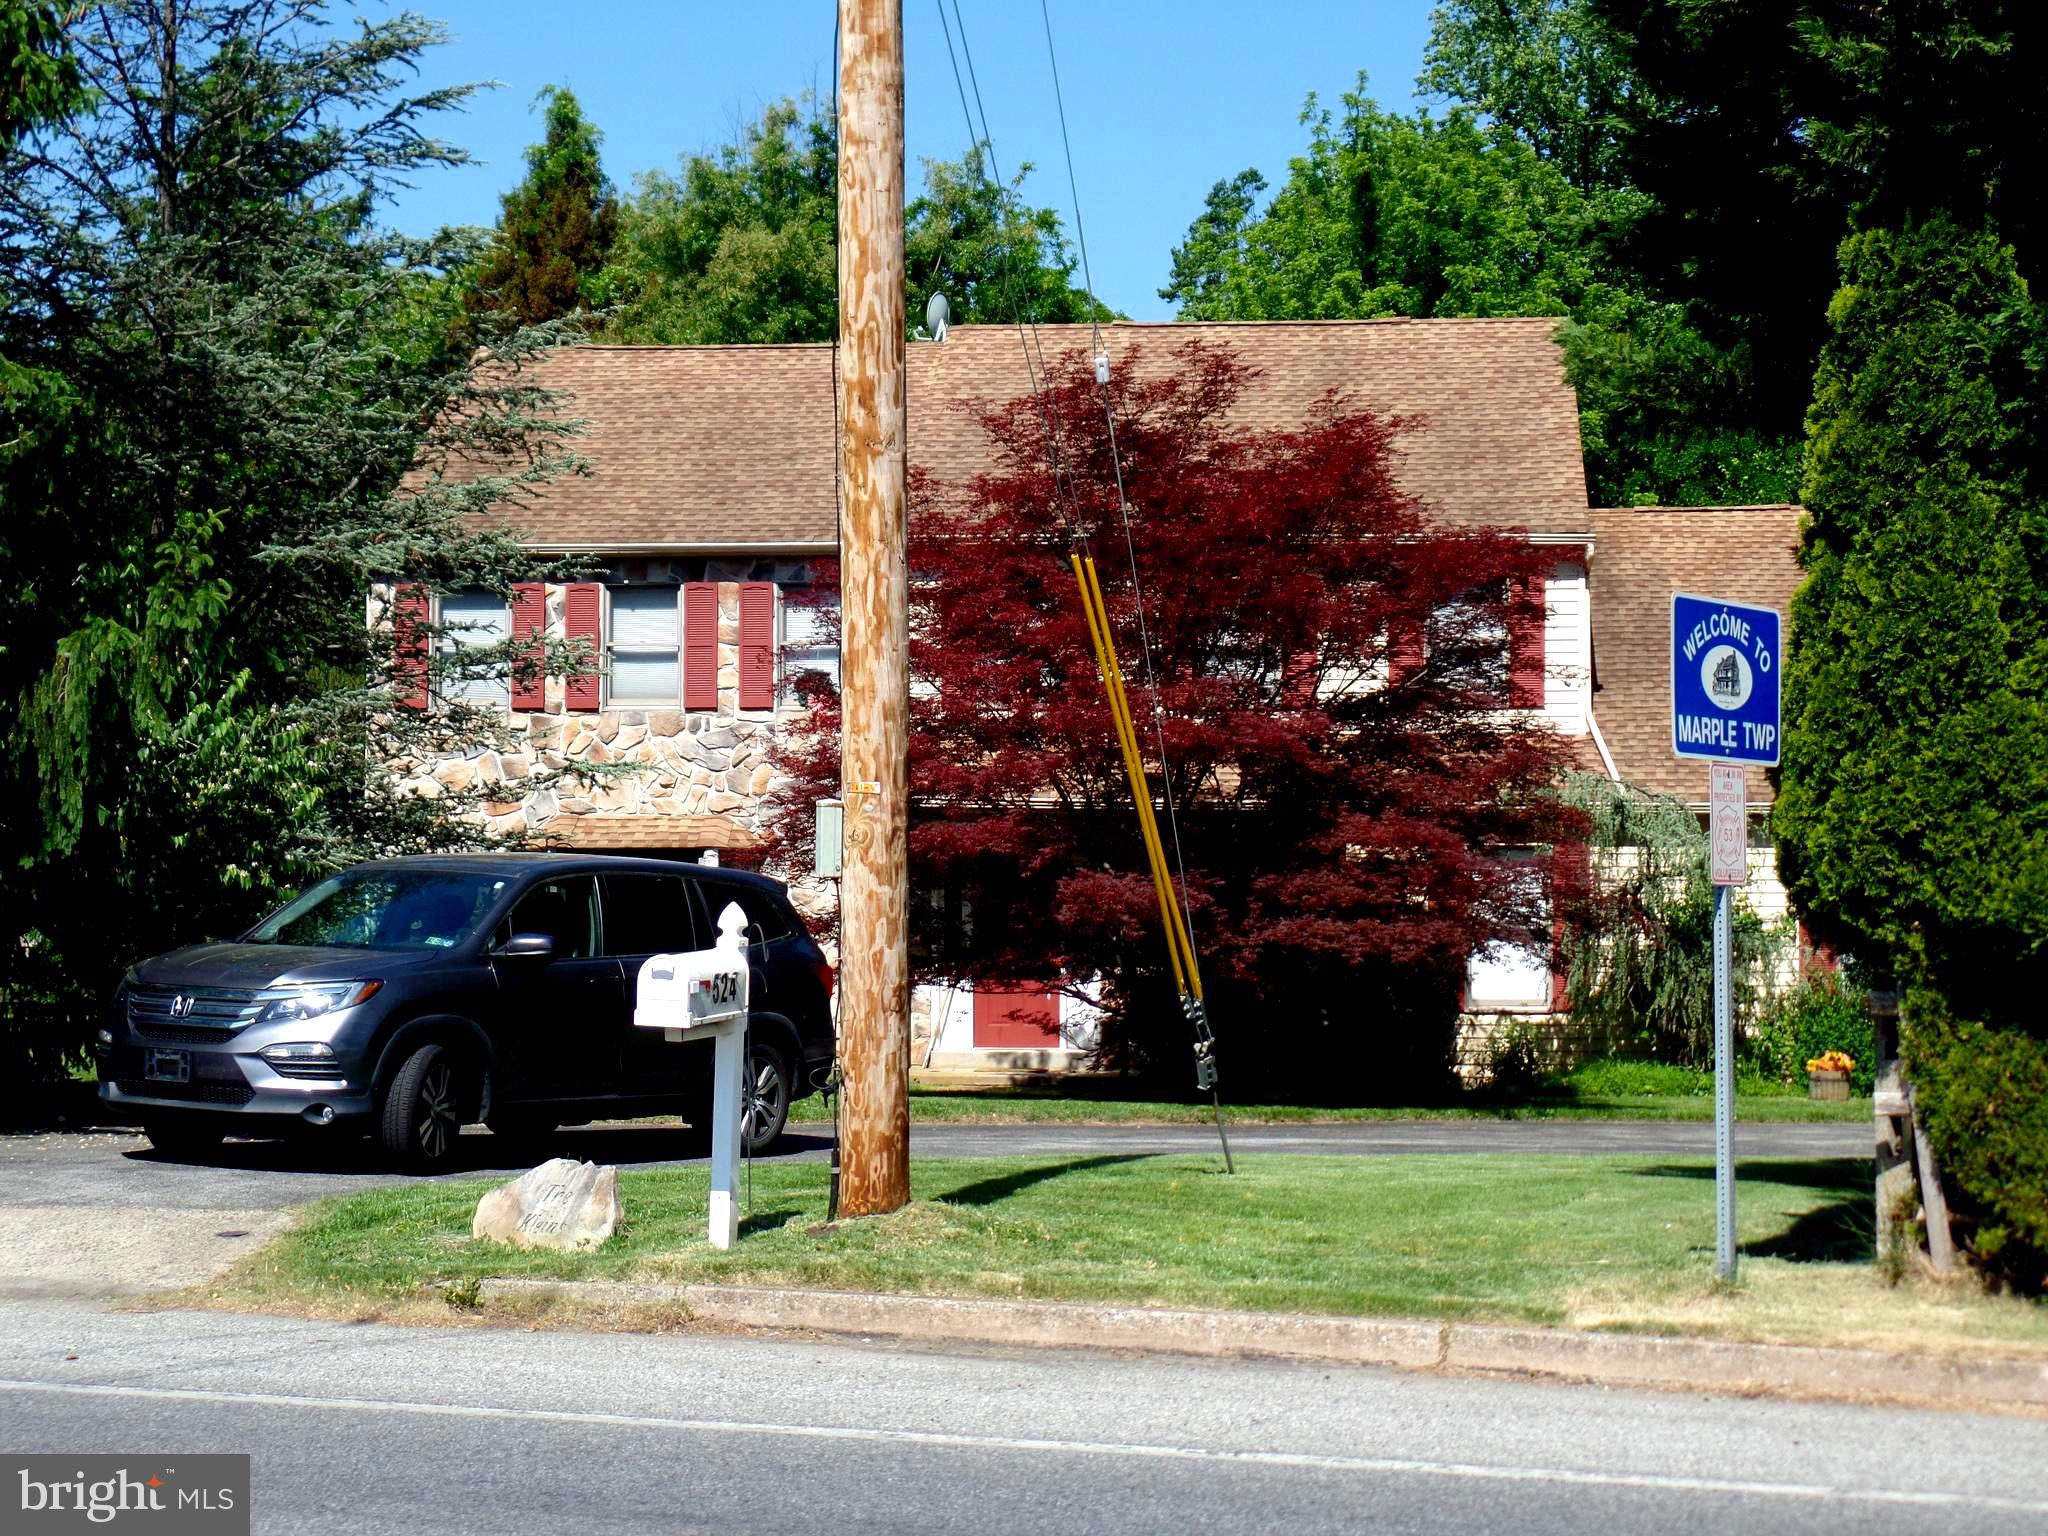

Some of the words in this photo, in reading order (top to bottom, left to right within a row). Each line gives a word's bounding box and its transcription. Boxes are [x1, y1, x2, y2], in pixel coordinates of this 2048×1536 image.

[1683, 612, 1751, 662] WELCOME
[1754, 636, 1771, 673] TO
[1678, 714, 1737, 748] MARPLE
[1743, 721, 1776, 751] TWP
[1724, 828, 1733, 842] 53
[712, 972, 737, 1004] 524
